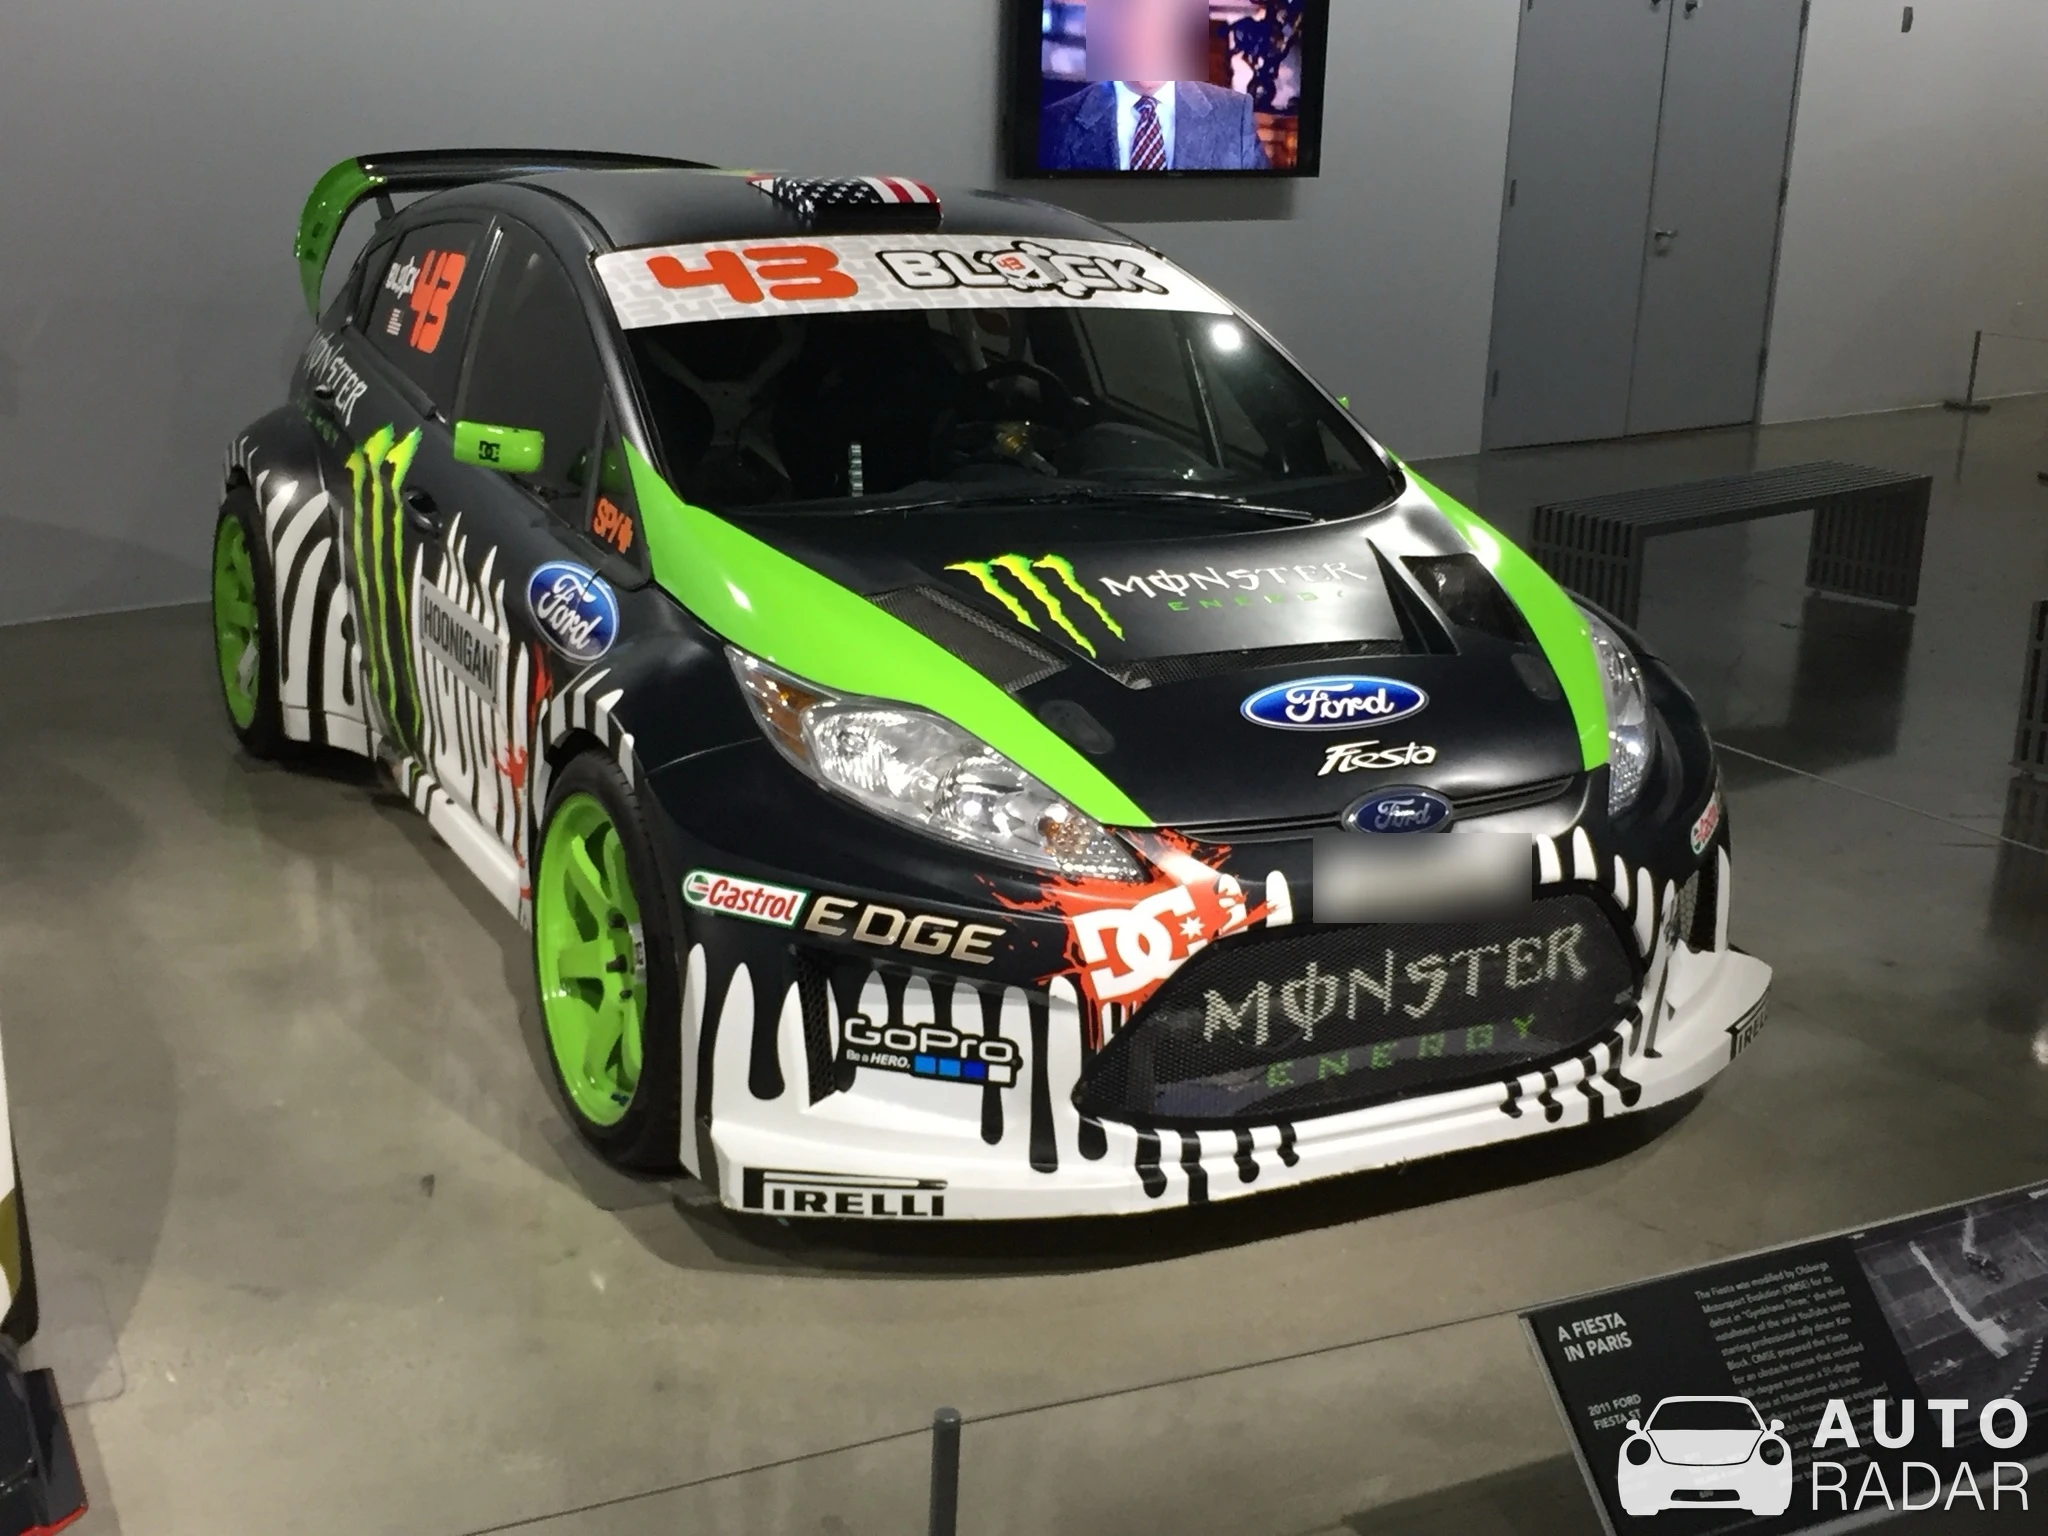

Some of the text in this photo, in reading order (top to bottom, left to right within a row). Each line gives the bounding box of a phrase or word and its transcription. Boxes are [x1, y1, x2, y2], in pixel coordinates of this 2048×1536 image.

[646, 244, 858, 303] 43
[537, 573, 603, 650] Ford
[1285, 683, 1394, 722] Ford
[1317, 740, 1436, 777] Fiesta
[1374, 799, 1431, 830] Ford
[708, 878, 1006, 964] Castrol EDGE
[844, 1017, 1014, 1063] GoPro
[743, 1167, 948, 1216] PIRELLI
[1558, 1312, 1627, 1342] A FIESTA
[1563, 1331, 1633, 1362] IN PARIS
[1588, 1394, 1641, 1416] 2011 FORD
[1593, 1413, 1628, 1430] FIESTA
